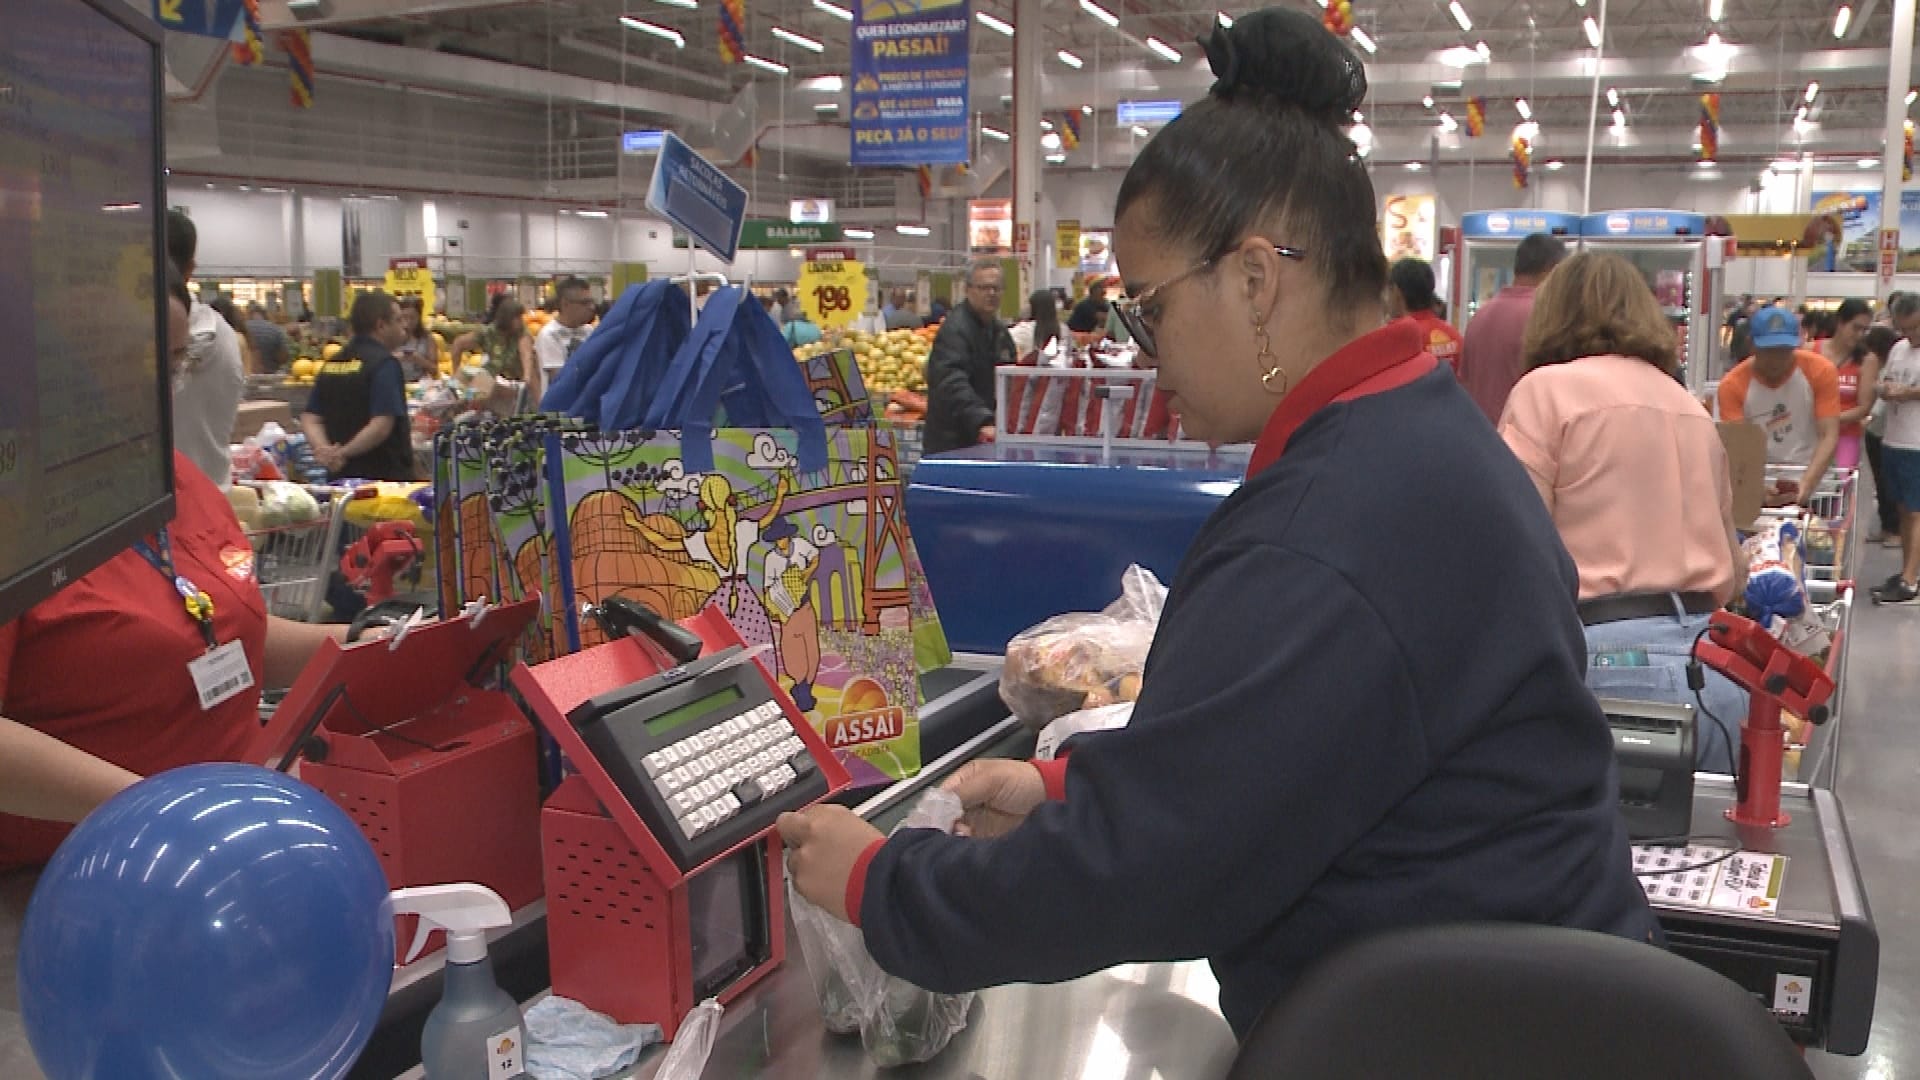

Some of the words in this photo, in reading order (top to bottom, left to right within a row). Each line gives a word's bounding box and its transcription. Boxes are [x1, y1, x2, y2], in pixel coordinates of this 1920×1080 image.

[856, 25, 887, 40] QUER
[888, 19, 967, 36] ECONOMIZAR?
[936, 96, 964, 107] PARA
[855, 129, 893, 145] PEÇA
[897, 124, 915, 142] JÁ
[917, 127, 928, 141] O
[766, 227, 821, 240] BALANÇA
